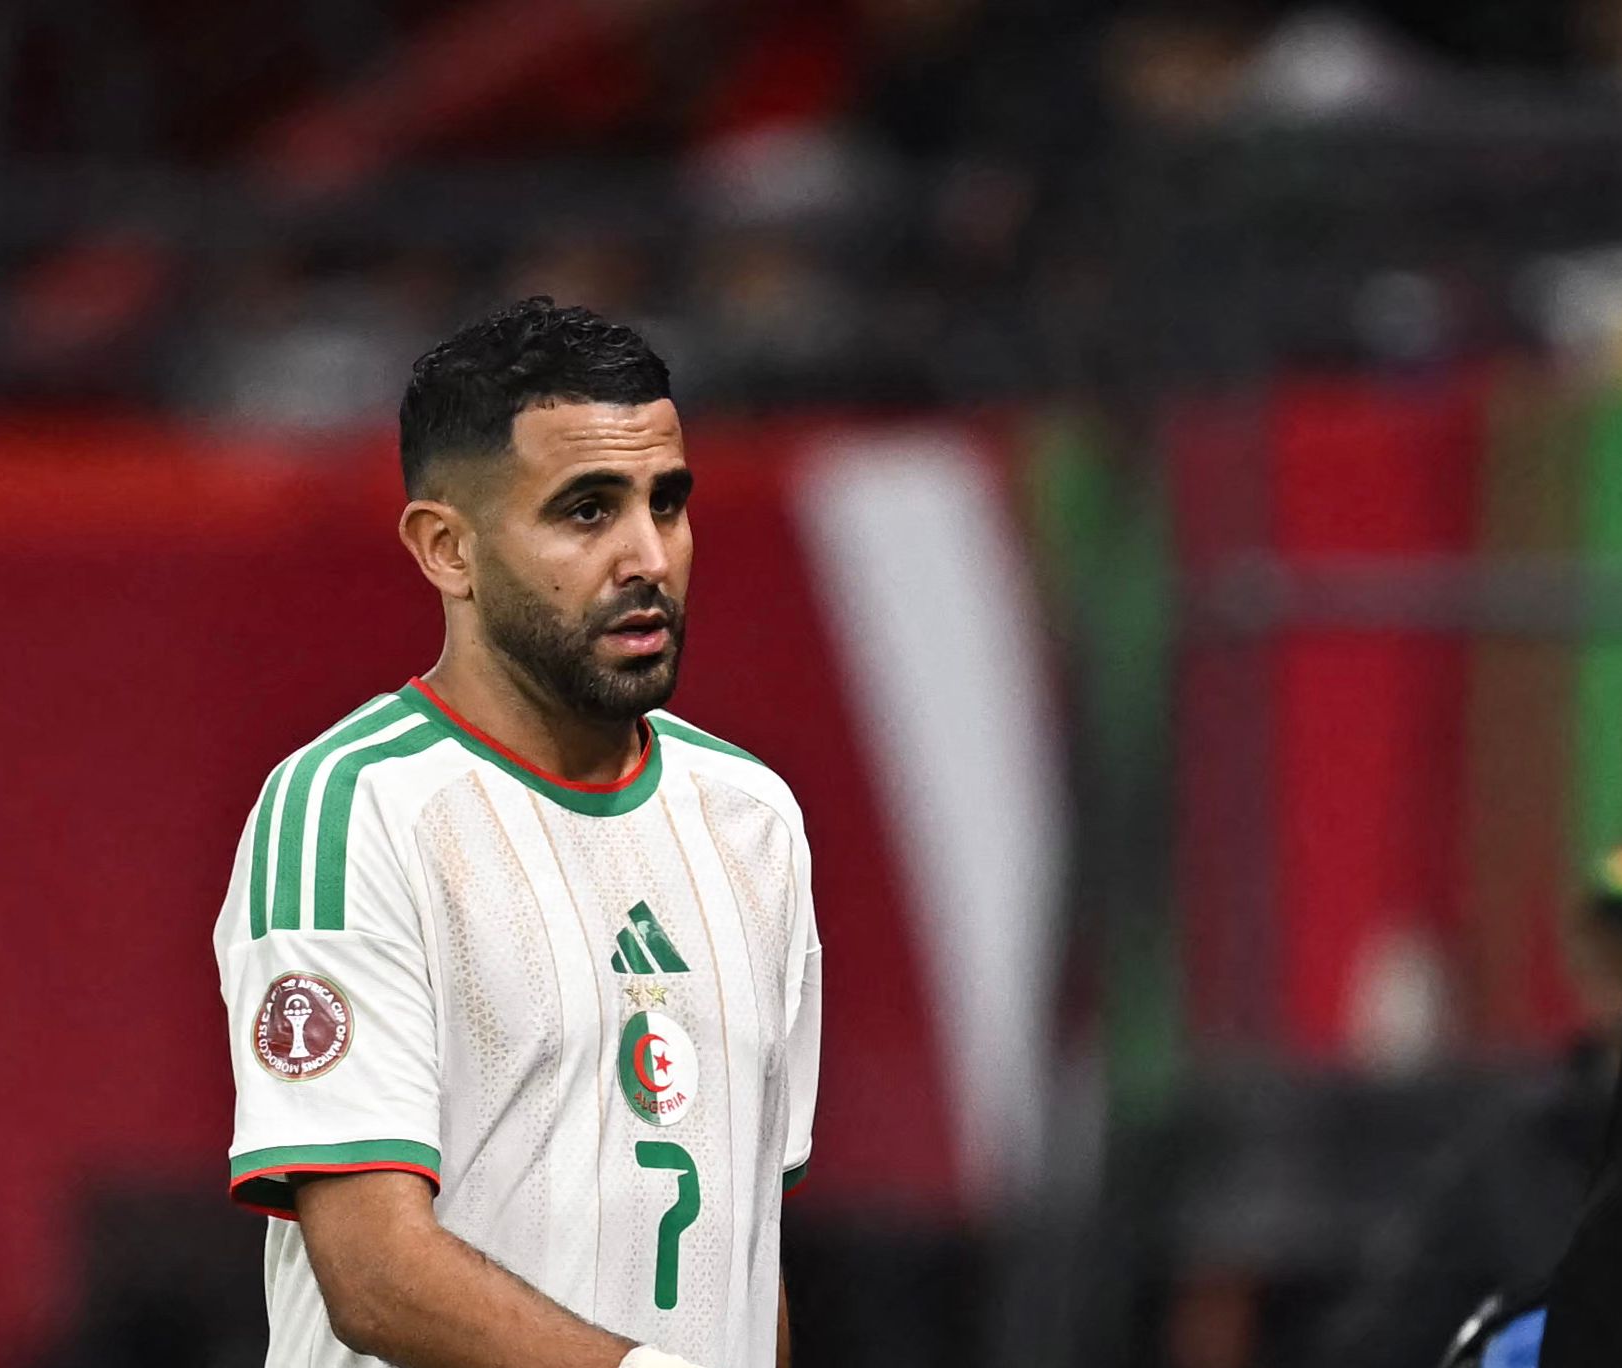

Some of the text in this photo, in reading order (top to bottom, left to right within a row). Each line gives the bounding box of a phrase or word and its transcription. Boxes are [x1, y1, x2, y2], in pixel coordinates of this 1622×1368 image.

[258, 1024, 300, 1074] MOROCCO 25
[298, 979, 346, 1073] AFRICA CUP OF NATIONS
[634, 1091, 687, 1115] ALGERIA
[635, 1141, 700, 1310] 7
